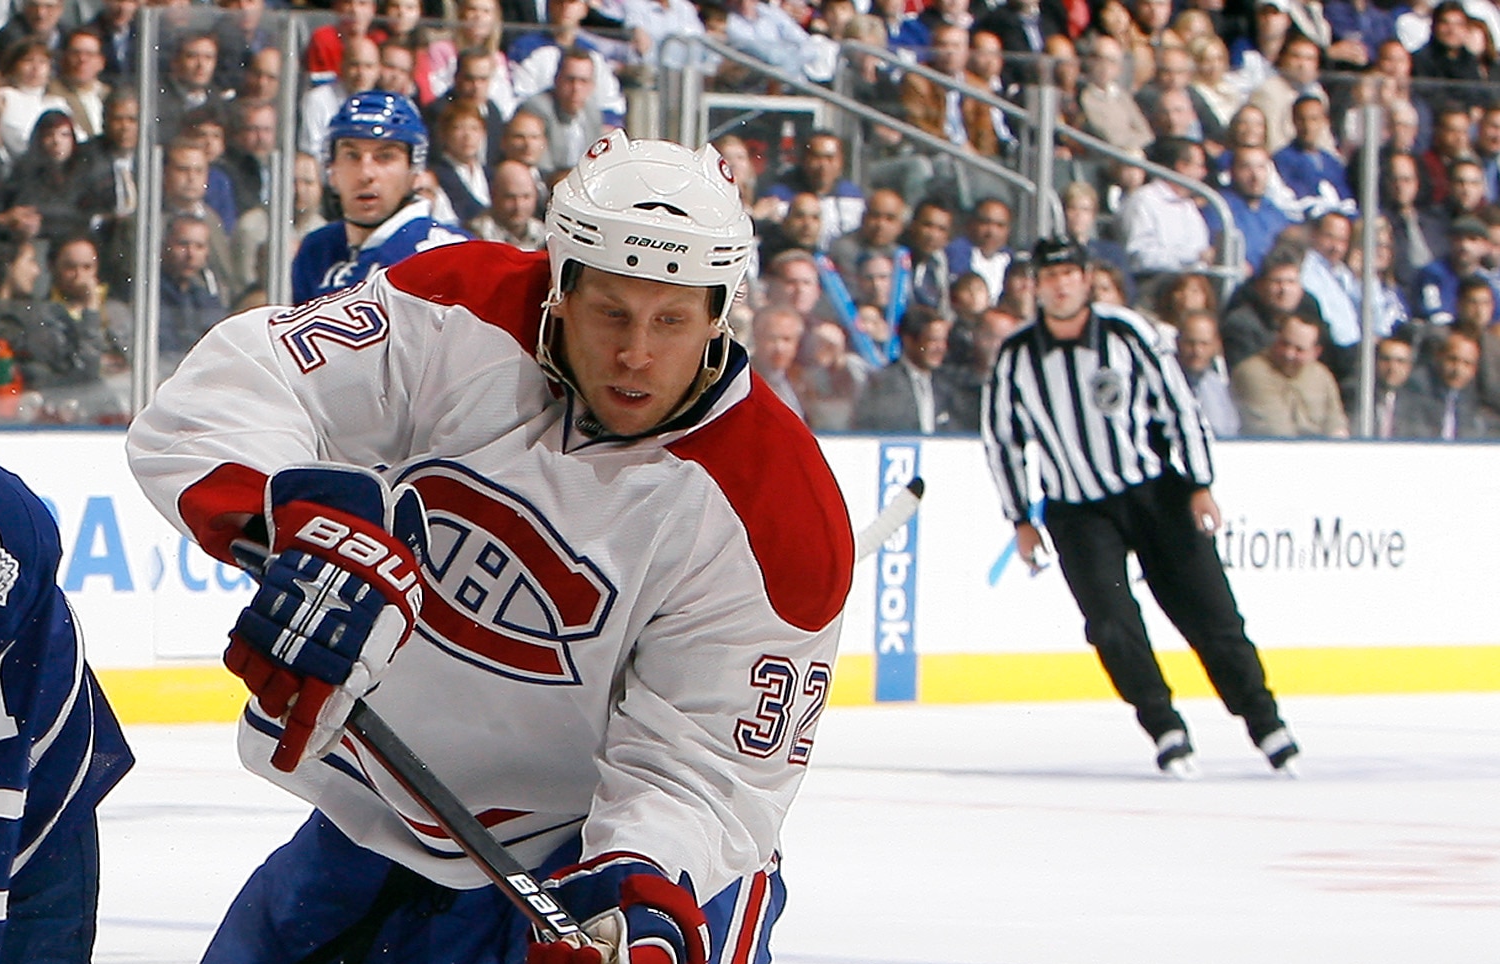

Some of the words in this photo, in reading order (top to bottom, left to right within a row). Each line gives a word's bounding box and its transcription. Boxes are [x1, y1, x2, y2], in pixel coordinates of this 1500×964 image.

[624, 235, 691, 255] BAUER
[269, 282, 390, 374] 2
[1221, 518, 1295, 570] tion
[1310, 516, 1407, 570] Move
[733, 654, 832, 765] 32
[505, 872, 581, 936] BAU
